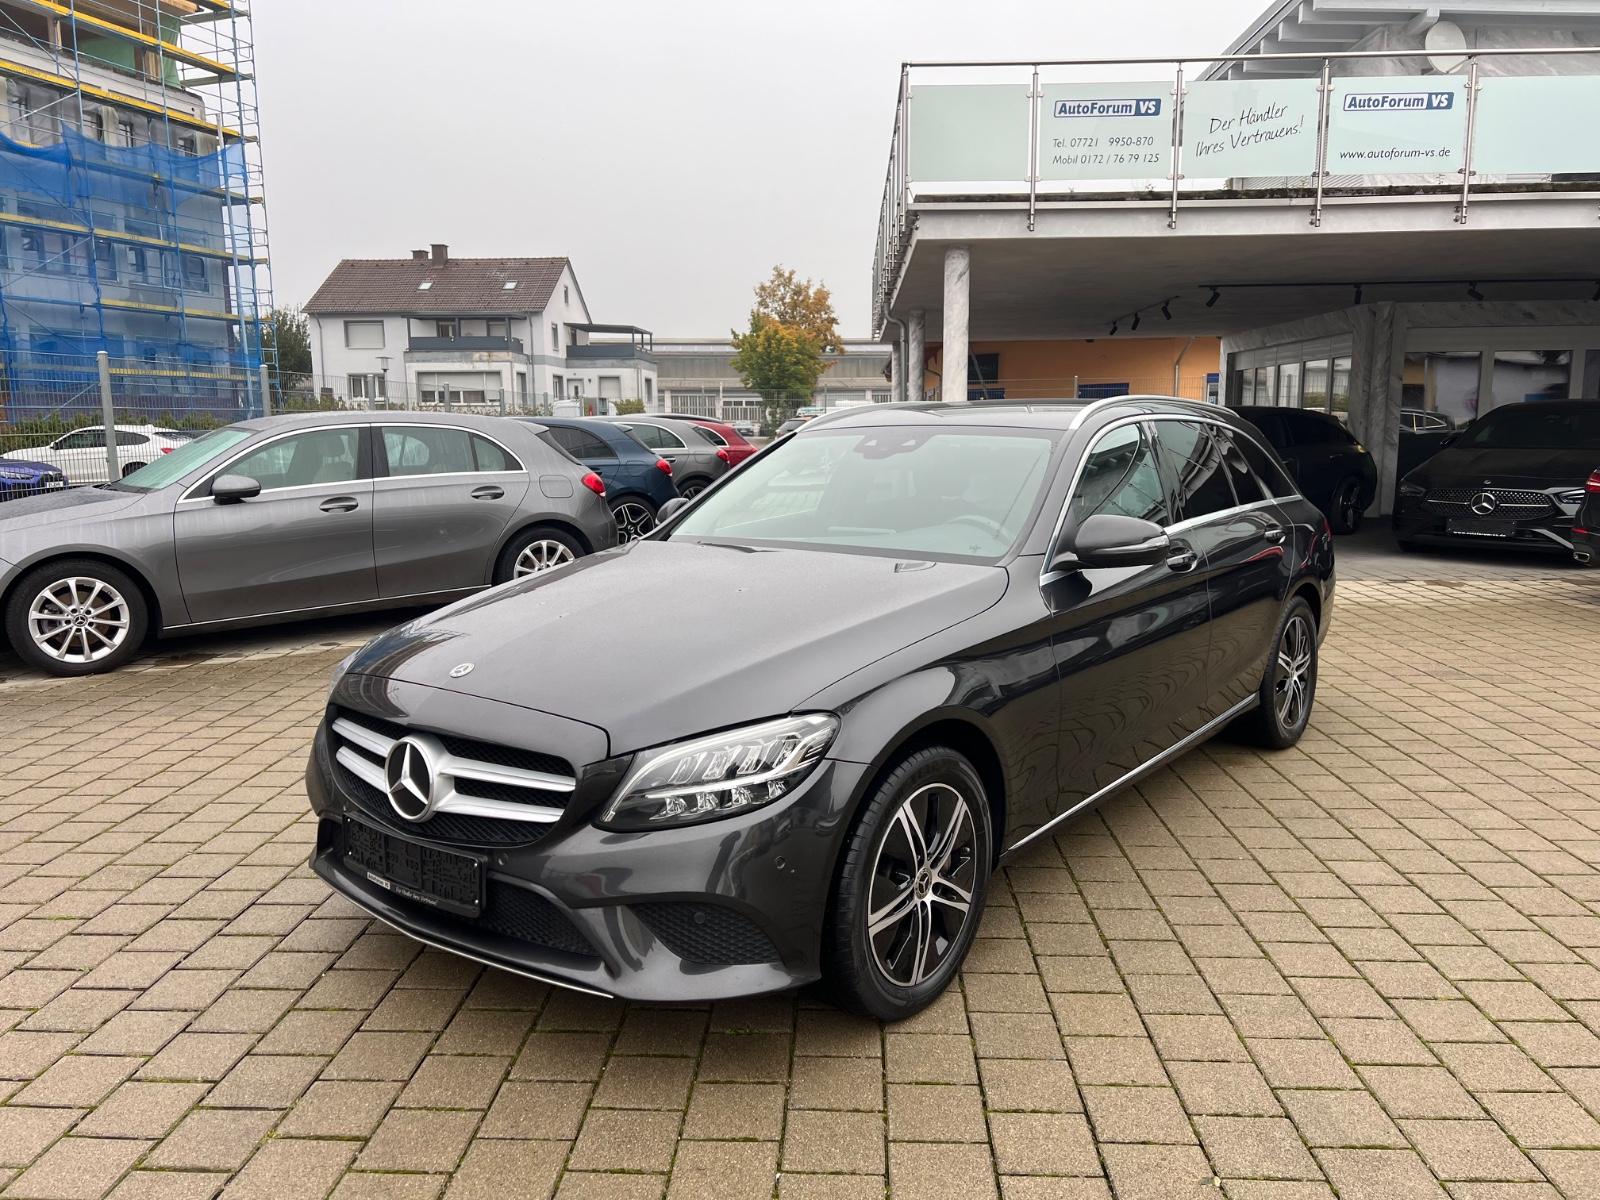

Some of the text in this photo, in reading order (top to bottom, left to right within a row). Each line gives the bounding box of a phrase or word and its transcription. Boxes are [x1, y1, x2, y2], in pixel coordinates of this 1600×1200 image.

[1058, 100, 1157, 115] AutoForum VS
[1347, 94, 1450, 109] AutoForum VS
[1209, 102, 1289, 134] Der Händler
[1052, 136, 1154, 148] Tel. 07721 9950-870
[1195, 114, 1305, 157] Ihres Vertrauens!
[1052, 154, 1079, 165] Mobil
[1080, 154, 1104, 164] 0172
[1113, 154, 1125, 164] 76
[1128, 153, 1140, 163] 79
[1143, 153, 1160, 163] 125
[1340, 147, 1451, 160] www.autoforum-vs.de
